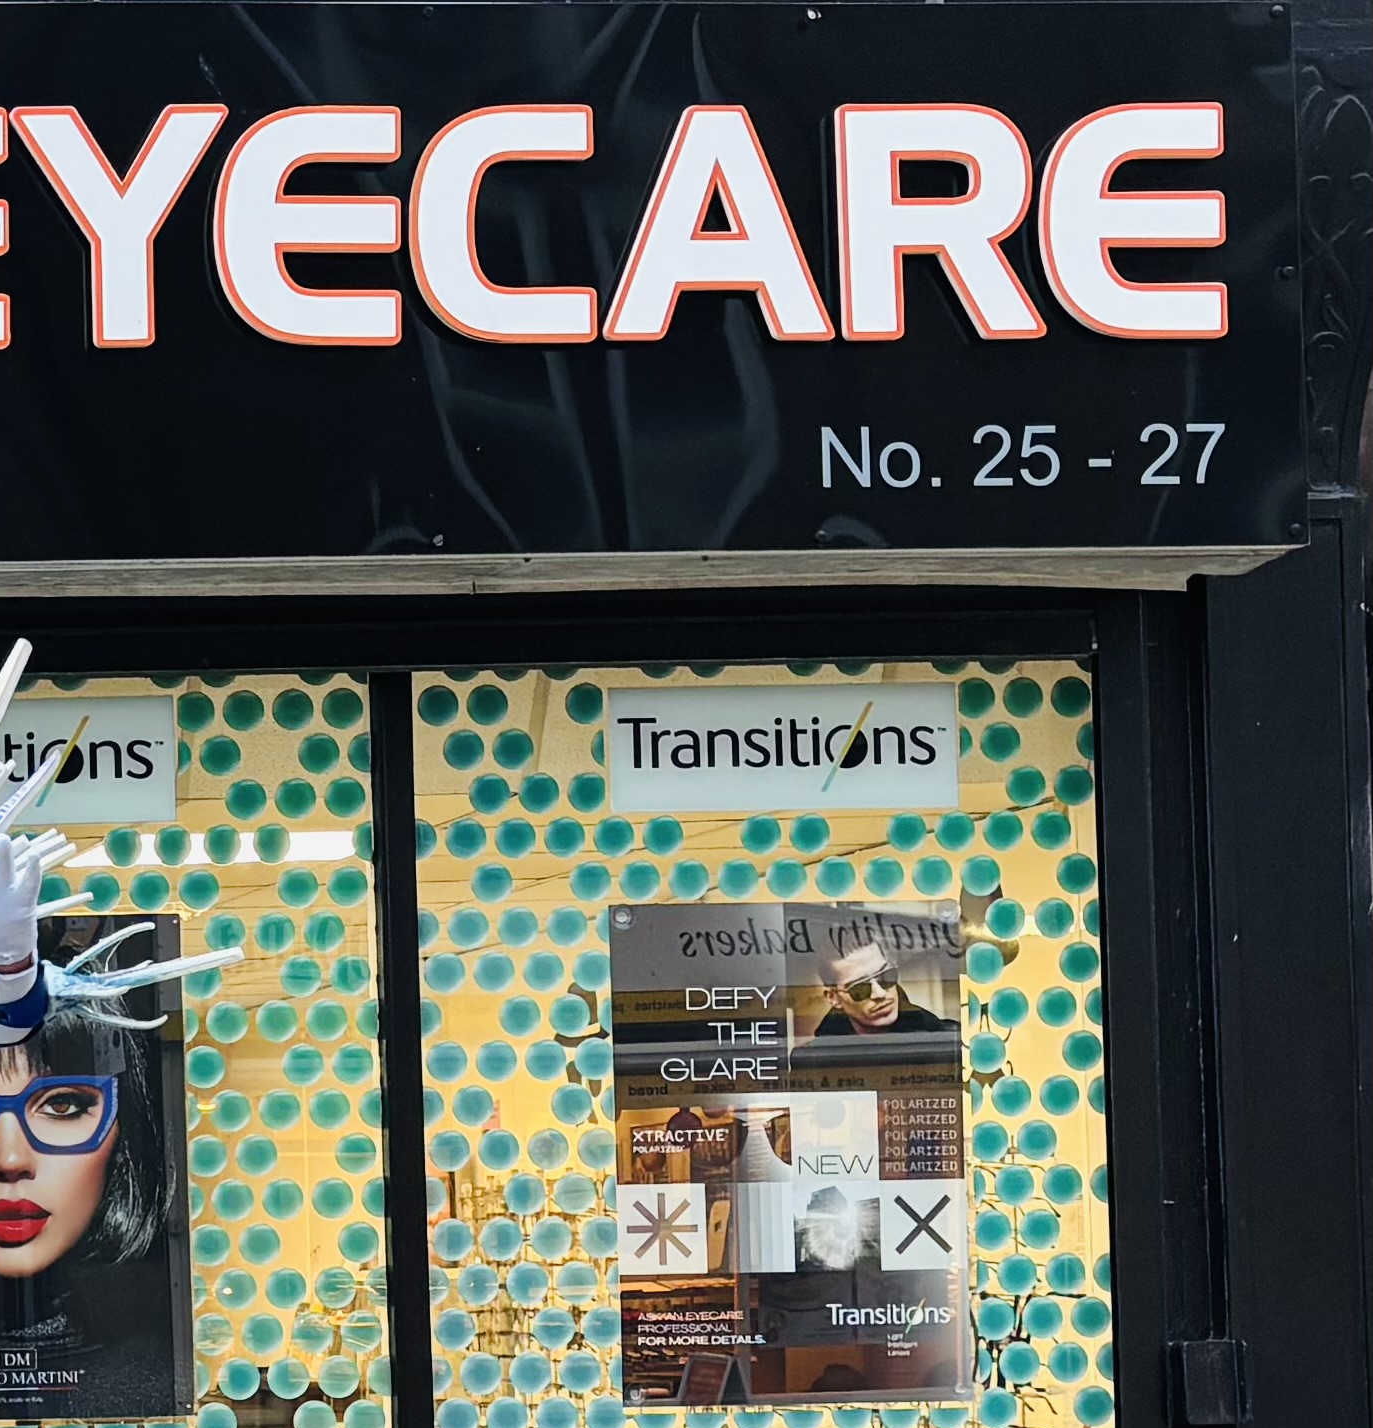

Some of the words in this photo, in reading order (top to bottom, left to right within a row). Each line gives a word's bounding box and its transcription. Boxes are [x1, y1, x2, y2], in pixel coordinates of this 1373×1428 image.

[819, 425, 942, 490] No.
[973, 425, 1058, 488] 25
[1139, 422, 1225, 485] 27
[685, 986, 777, 1011] DEFY
[707, 1021, 778, 1046] THE
[660, 1056, 779, 1082] GLARE
[884, 1098, 956, 1109] POLARIZED
[884, 1114, 956, 1126] POLARIZED
[632, 1129, 727, 1143] XTRACTIVE
[885, 1130, 957, 1141] POLARIZED
[886, 1146, 958, 1157] POLARIZED
[799, 1154, 874, 1174] NEW
[886, 1161, 958, 1172] POLARIZED
[686, 1310, 744, 1321] EYECARE
[638, 1323, 733, 1334] PROFESSIONAL
[638, 1336, 666, 1346] FOR
[669, 1335, 710, 1346] MORE
[4, 1353, 30, 1366] DM
